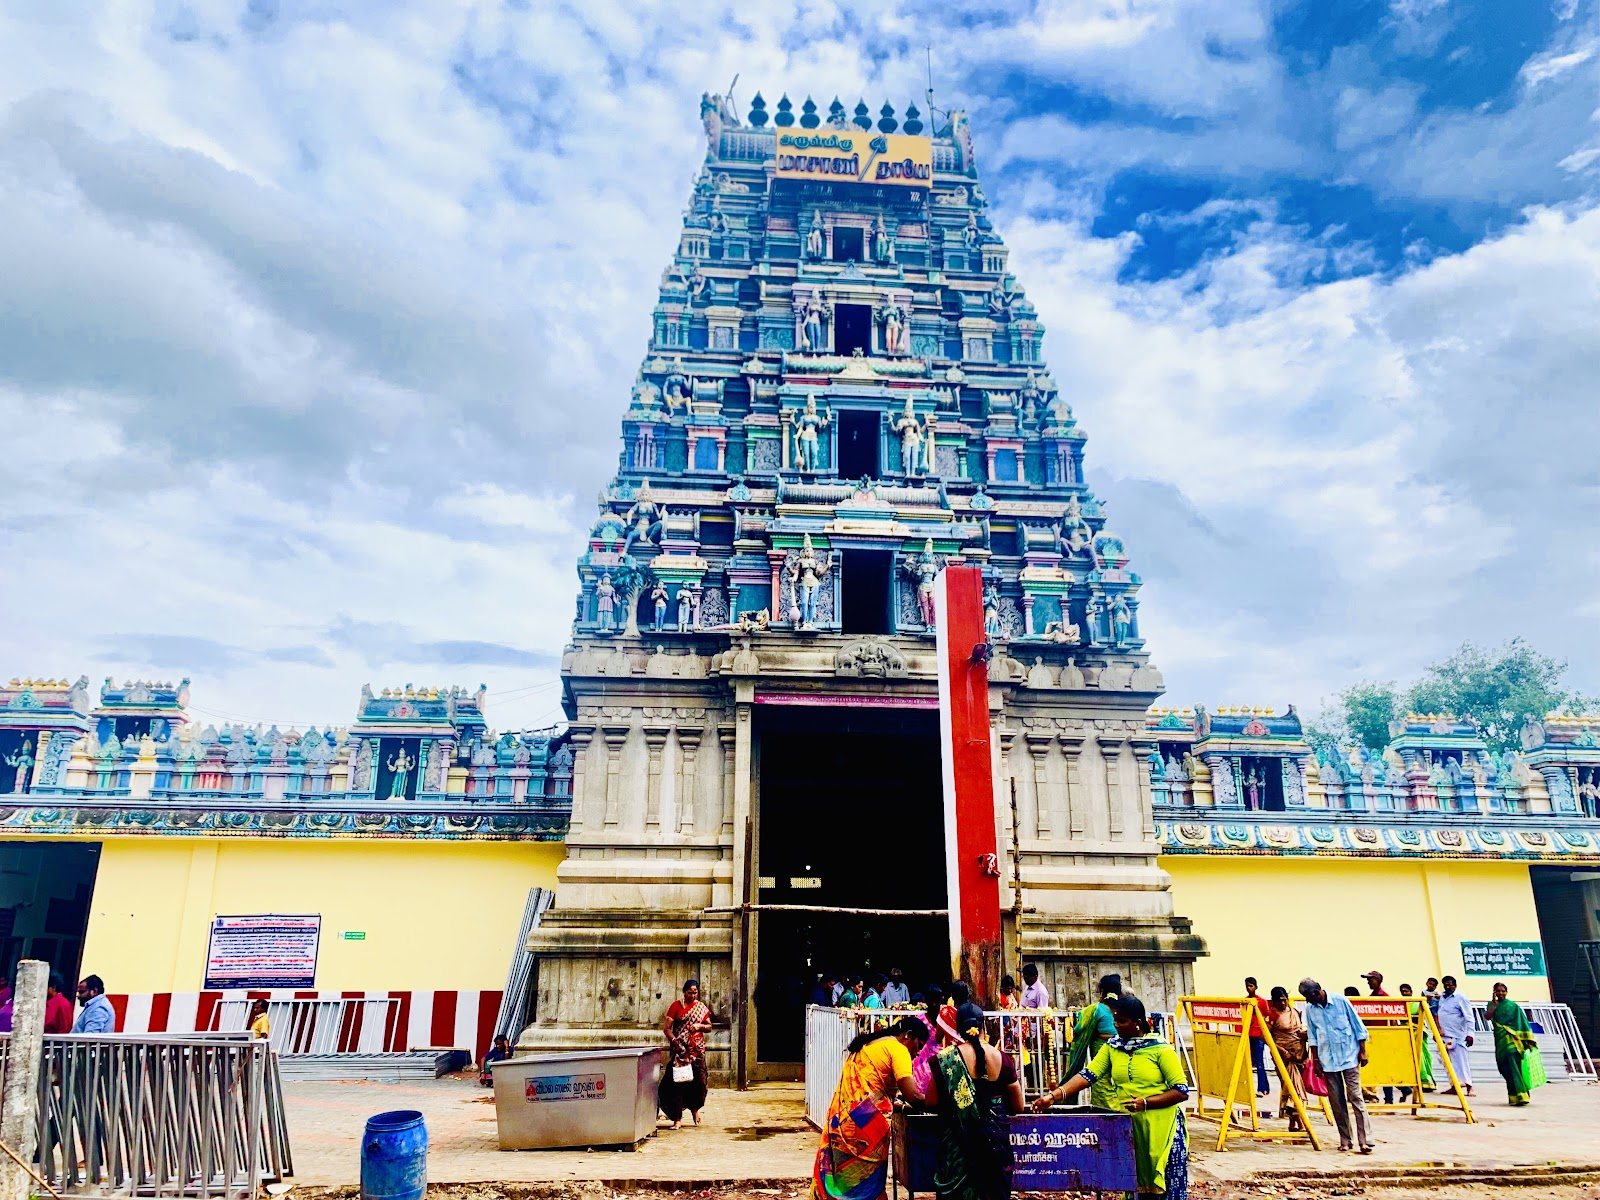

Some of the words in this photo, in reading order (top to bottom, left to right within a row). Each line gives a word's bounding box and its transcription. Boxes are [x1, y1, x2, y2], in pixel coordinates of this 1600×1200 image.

[780, 135, 853, 151] அருள்மிகு
[779, 153, 859, 176] மாசாணி
[875, 158, 930, 180] தாயே
[1353, 1004, 1382, 1014] DISTRICT
[1383, 1004, 1405, 1015] POLICE
[1044, 1127, 1098, 1148] ஹவுஸ்
